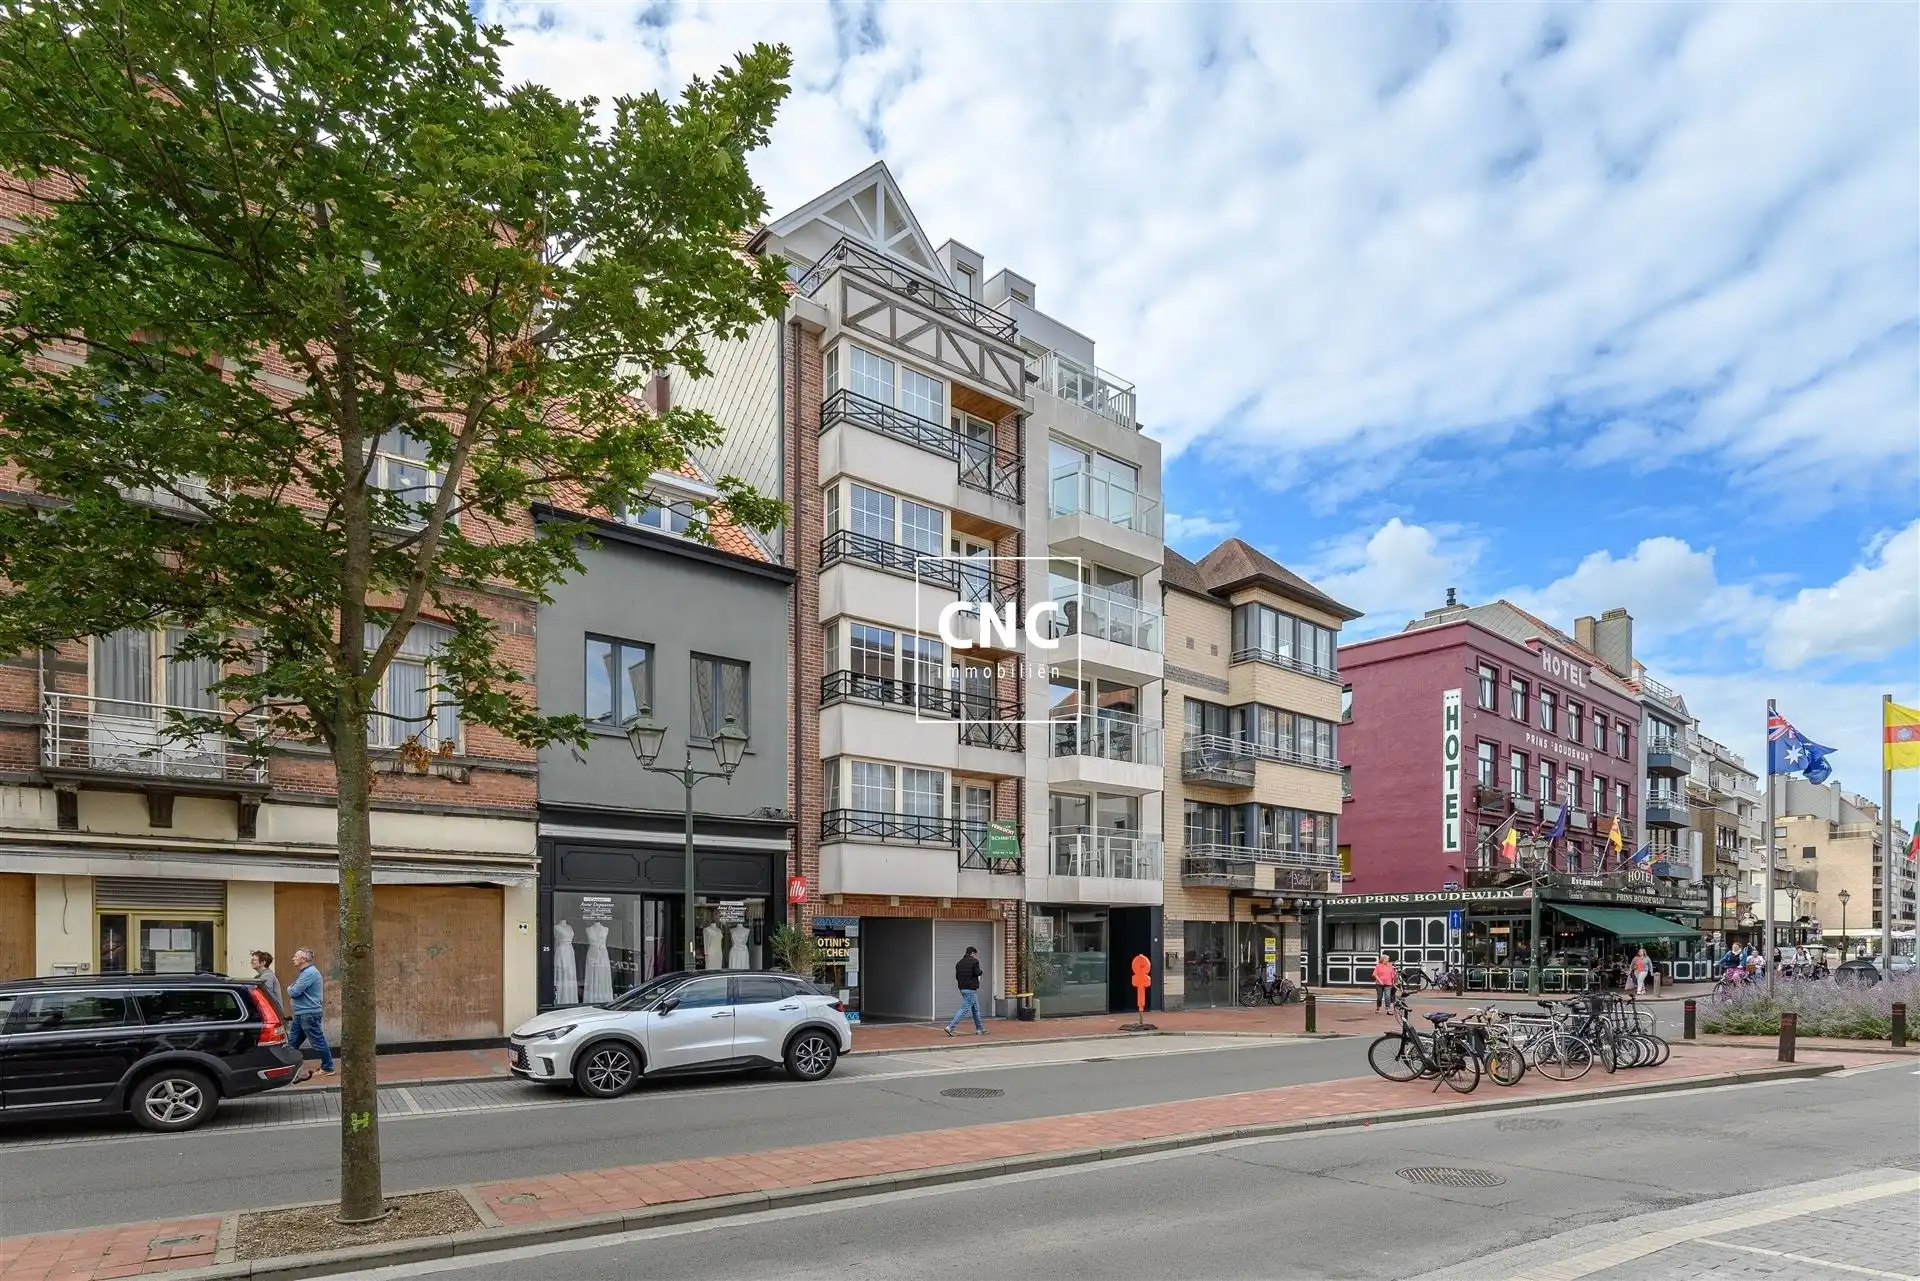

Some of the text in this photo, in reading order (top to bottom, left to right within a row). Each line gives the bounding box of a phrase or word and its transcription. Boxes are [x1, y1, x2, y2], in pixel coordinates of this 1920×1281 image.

[1542, 650, 1587, 689] HOTEL
[1525, 732, 1548, 749] PRINS
[1445, 704, 1459, 849] HOTEL
[1628, 870, 1655, 886] HOTEL
[790, 880, 805, 900] illy
[1326, 890, 1514, 905] Hotel PRINS BOUDEWIJN
[1616, 893, 1665, 905] PRINS BOUDEWIJN
[817, 937, 850, 947] OTINI'S
